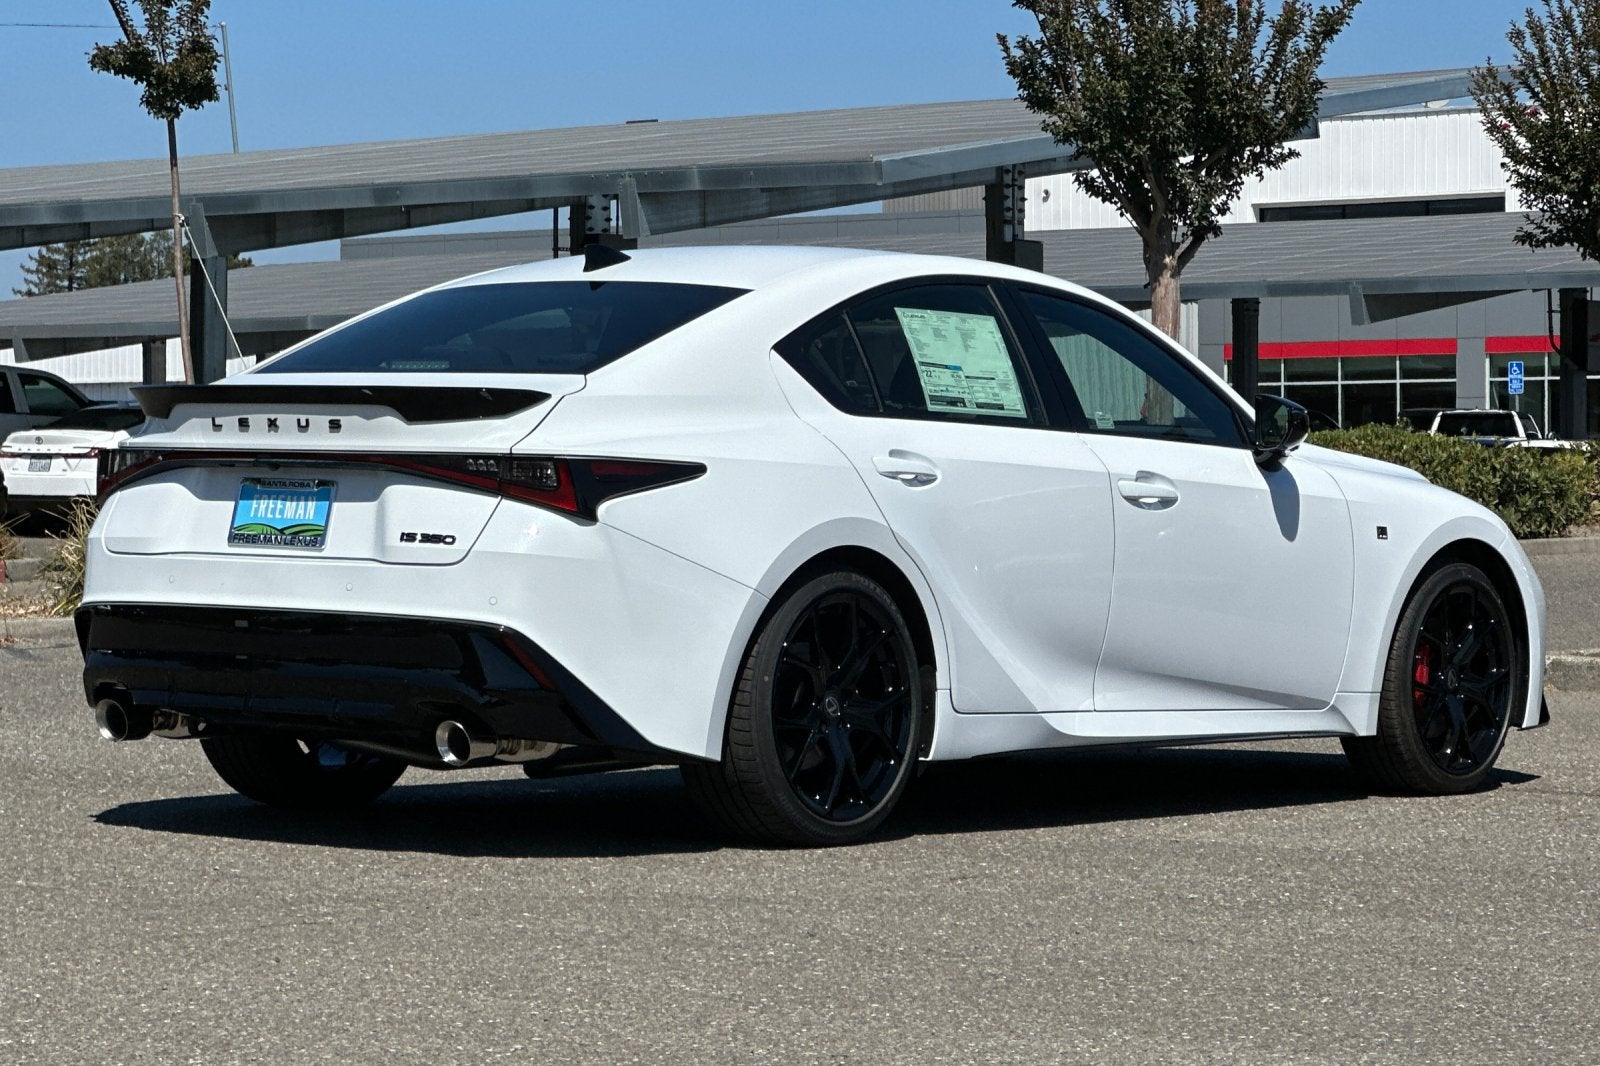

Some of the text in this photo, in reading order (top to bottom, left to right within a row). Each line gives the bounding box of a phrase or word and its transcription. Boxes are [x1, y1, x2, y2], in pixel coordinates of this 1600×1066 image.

[211, 416, 342, 430] LEXUS
[261, 480, 312, 489] SANTA ROSA
[250, 494, 316, 519] FREEMAN
[232, 532, 319, 547] FREEMAN LEXUS
[399, 531, 457, 546] IS 350
